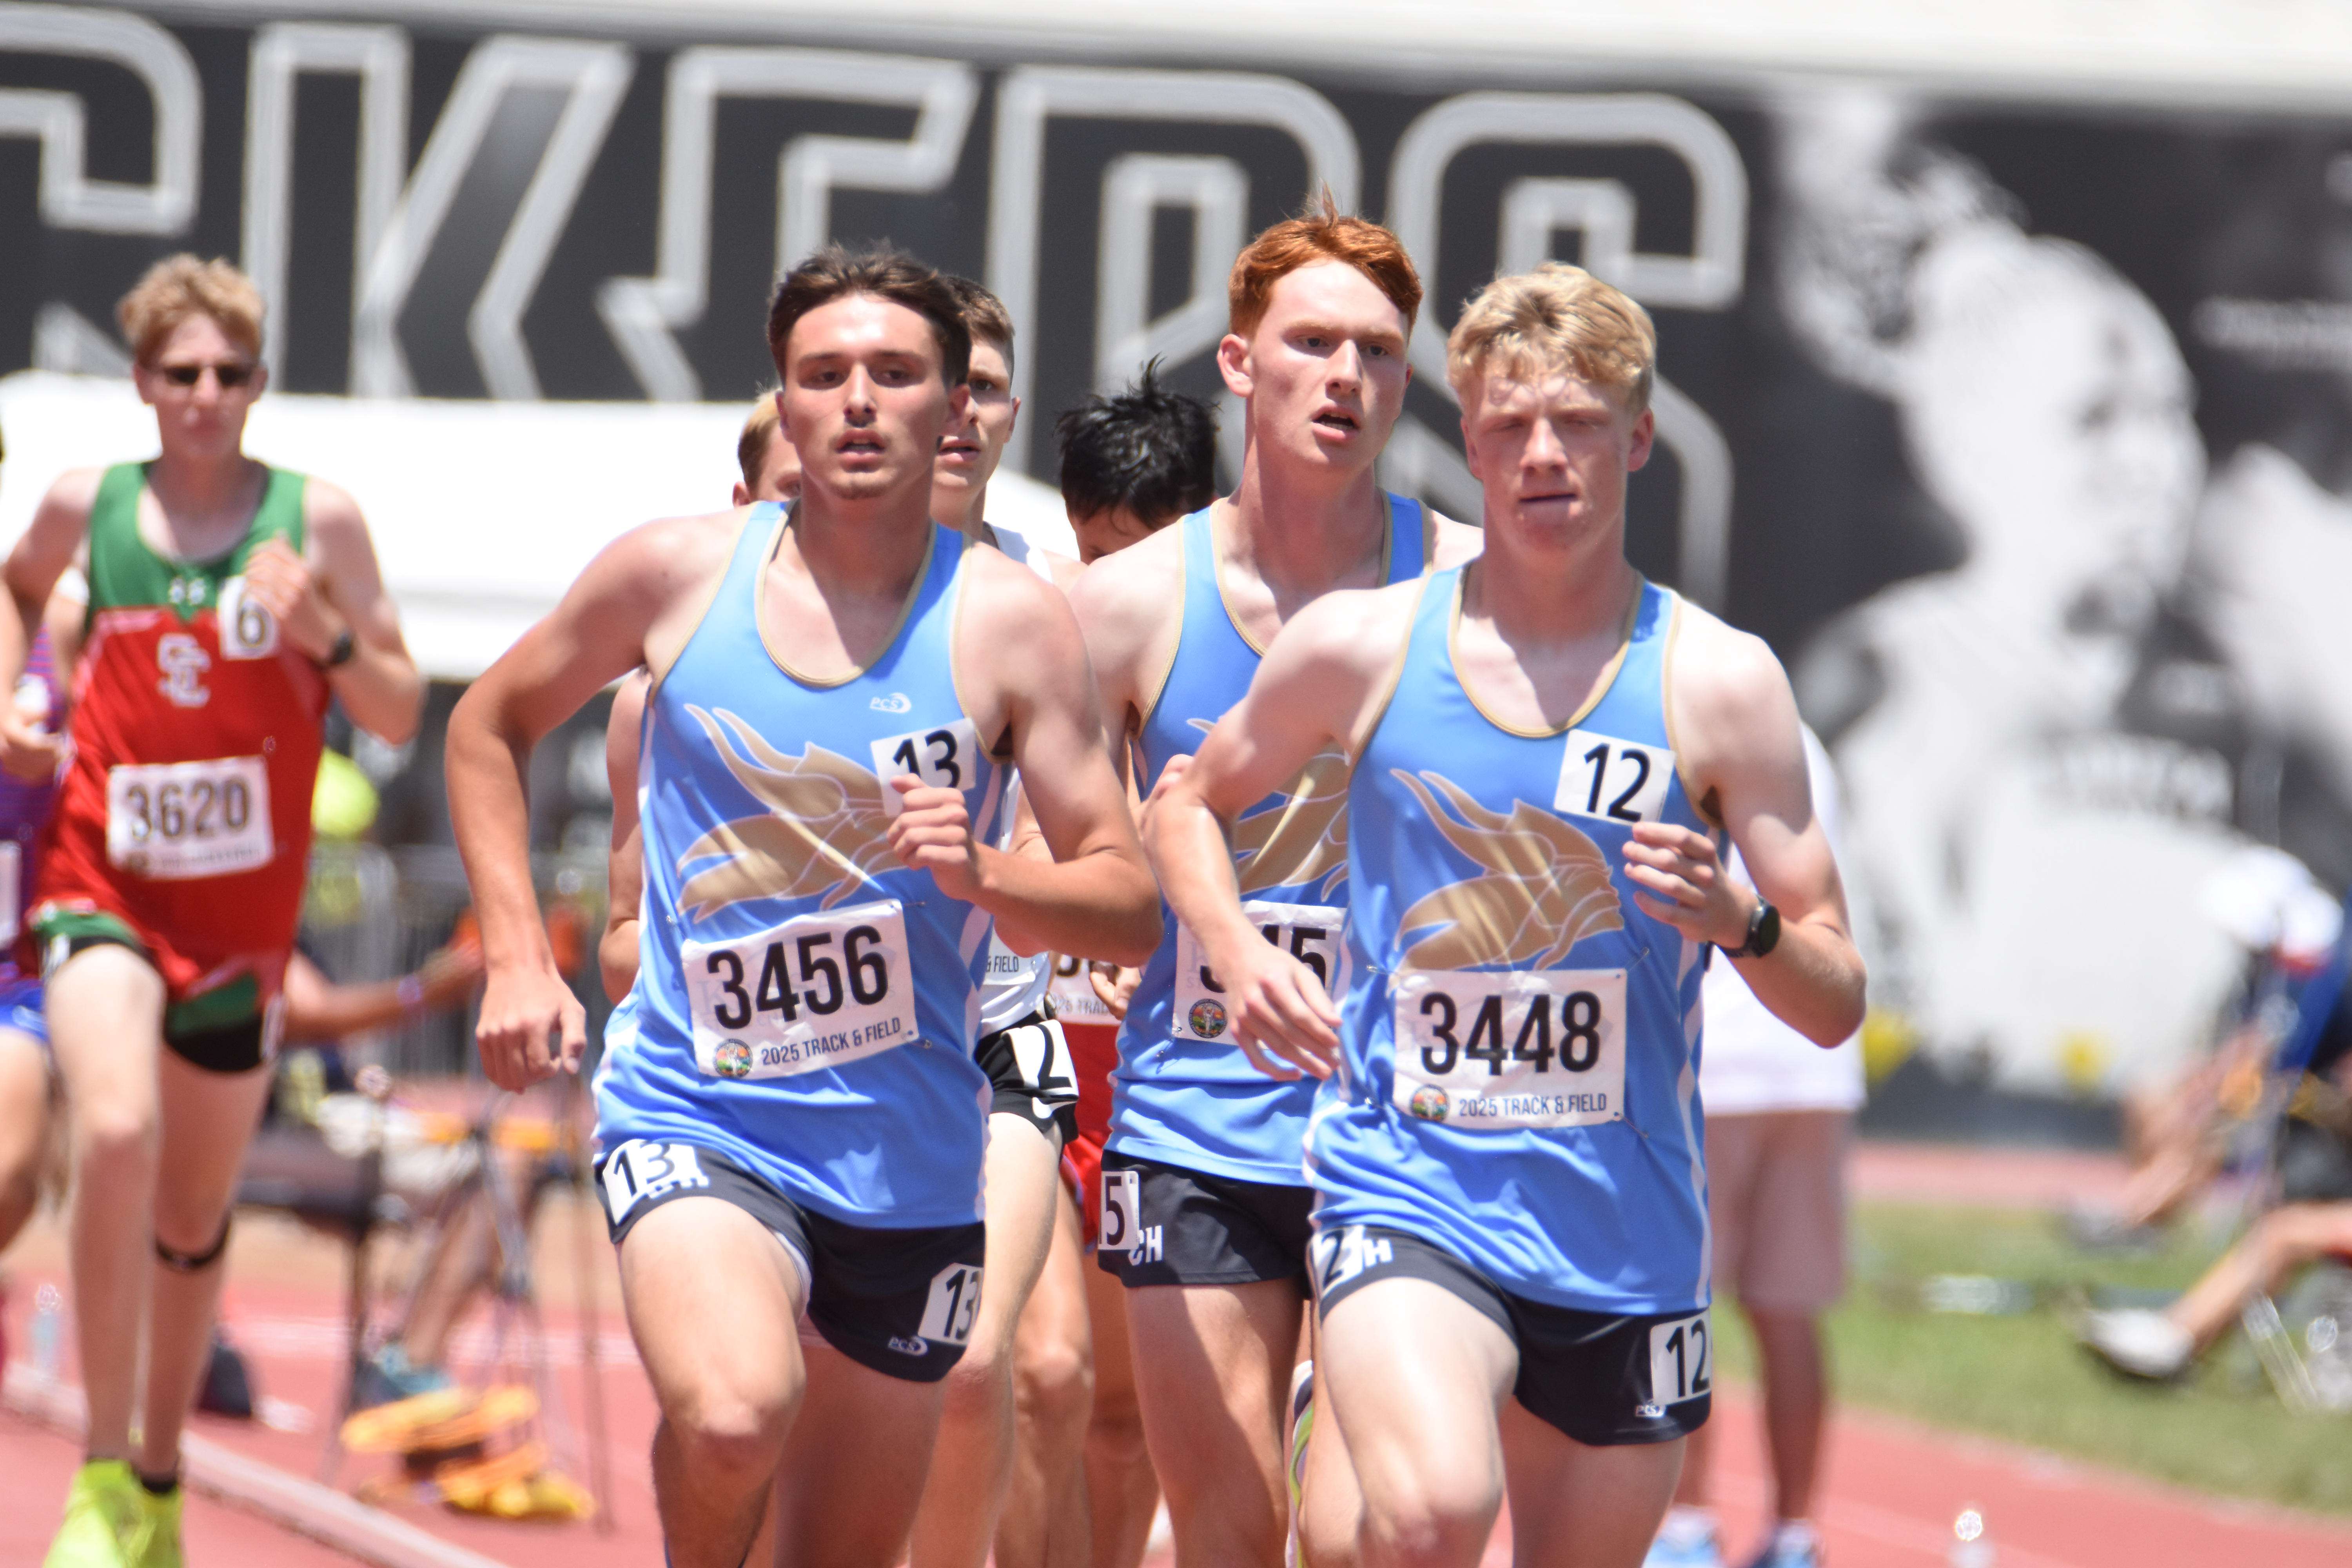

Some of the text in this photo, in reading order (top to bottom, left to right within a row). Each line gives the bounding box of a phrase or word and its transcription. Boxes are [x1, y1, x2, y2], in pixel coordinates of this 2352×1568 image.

[893, 730, 960, 788] 13
[1584, 742, 1651, 822] 12
[127, 777, 251, 840] 3620
[706, 925, 888, 1030] 3456
[994, 956, 1019, 973] FIELD
[761, 1044, 800, 1065] 2025
[802, 1032, 849, 1058] TRACK
[853, 1029, 862, 1047] &
[865, 1017, 901, 1042] FIELD
[1420, 991, 1601, 1076] 3448
[1459, 1098, 1497, 1116] 2025
[1503, 1096, 1550, 1116] TRACK
[1555, 1095, 1564, 1113] &
[1567, 1093, 1607, 1113] FIELD
[613, 1140, 676, 1198] 13
[1099, 1176, 1125, 1246] 5
[944, 1269, 981, 1340] 13
[1666, 1319, 1710, 1398] 12
